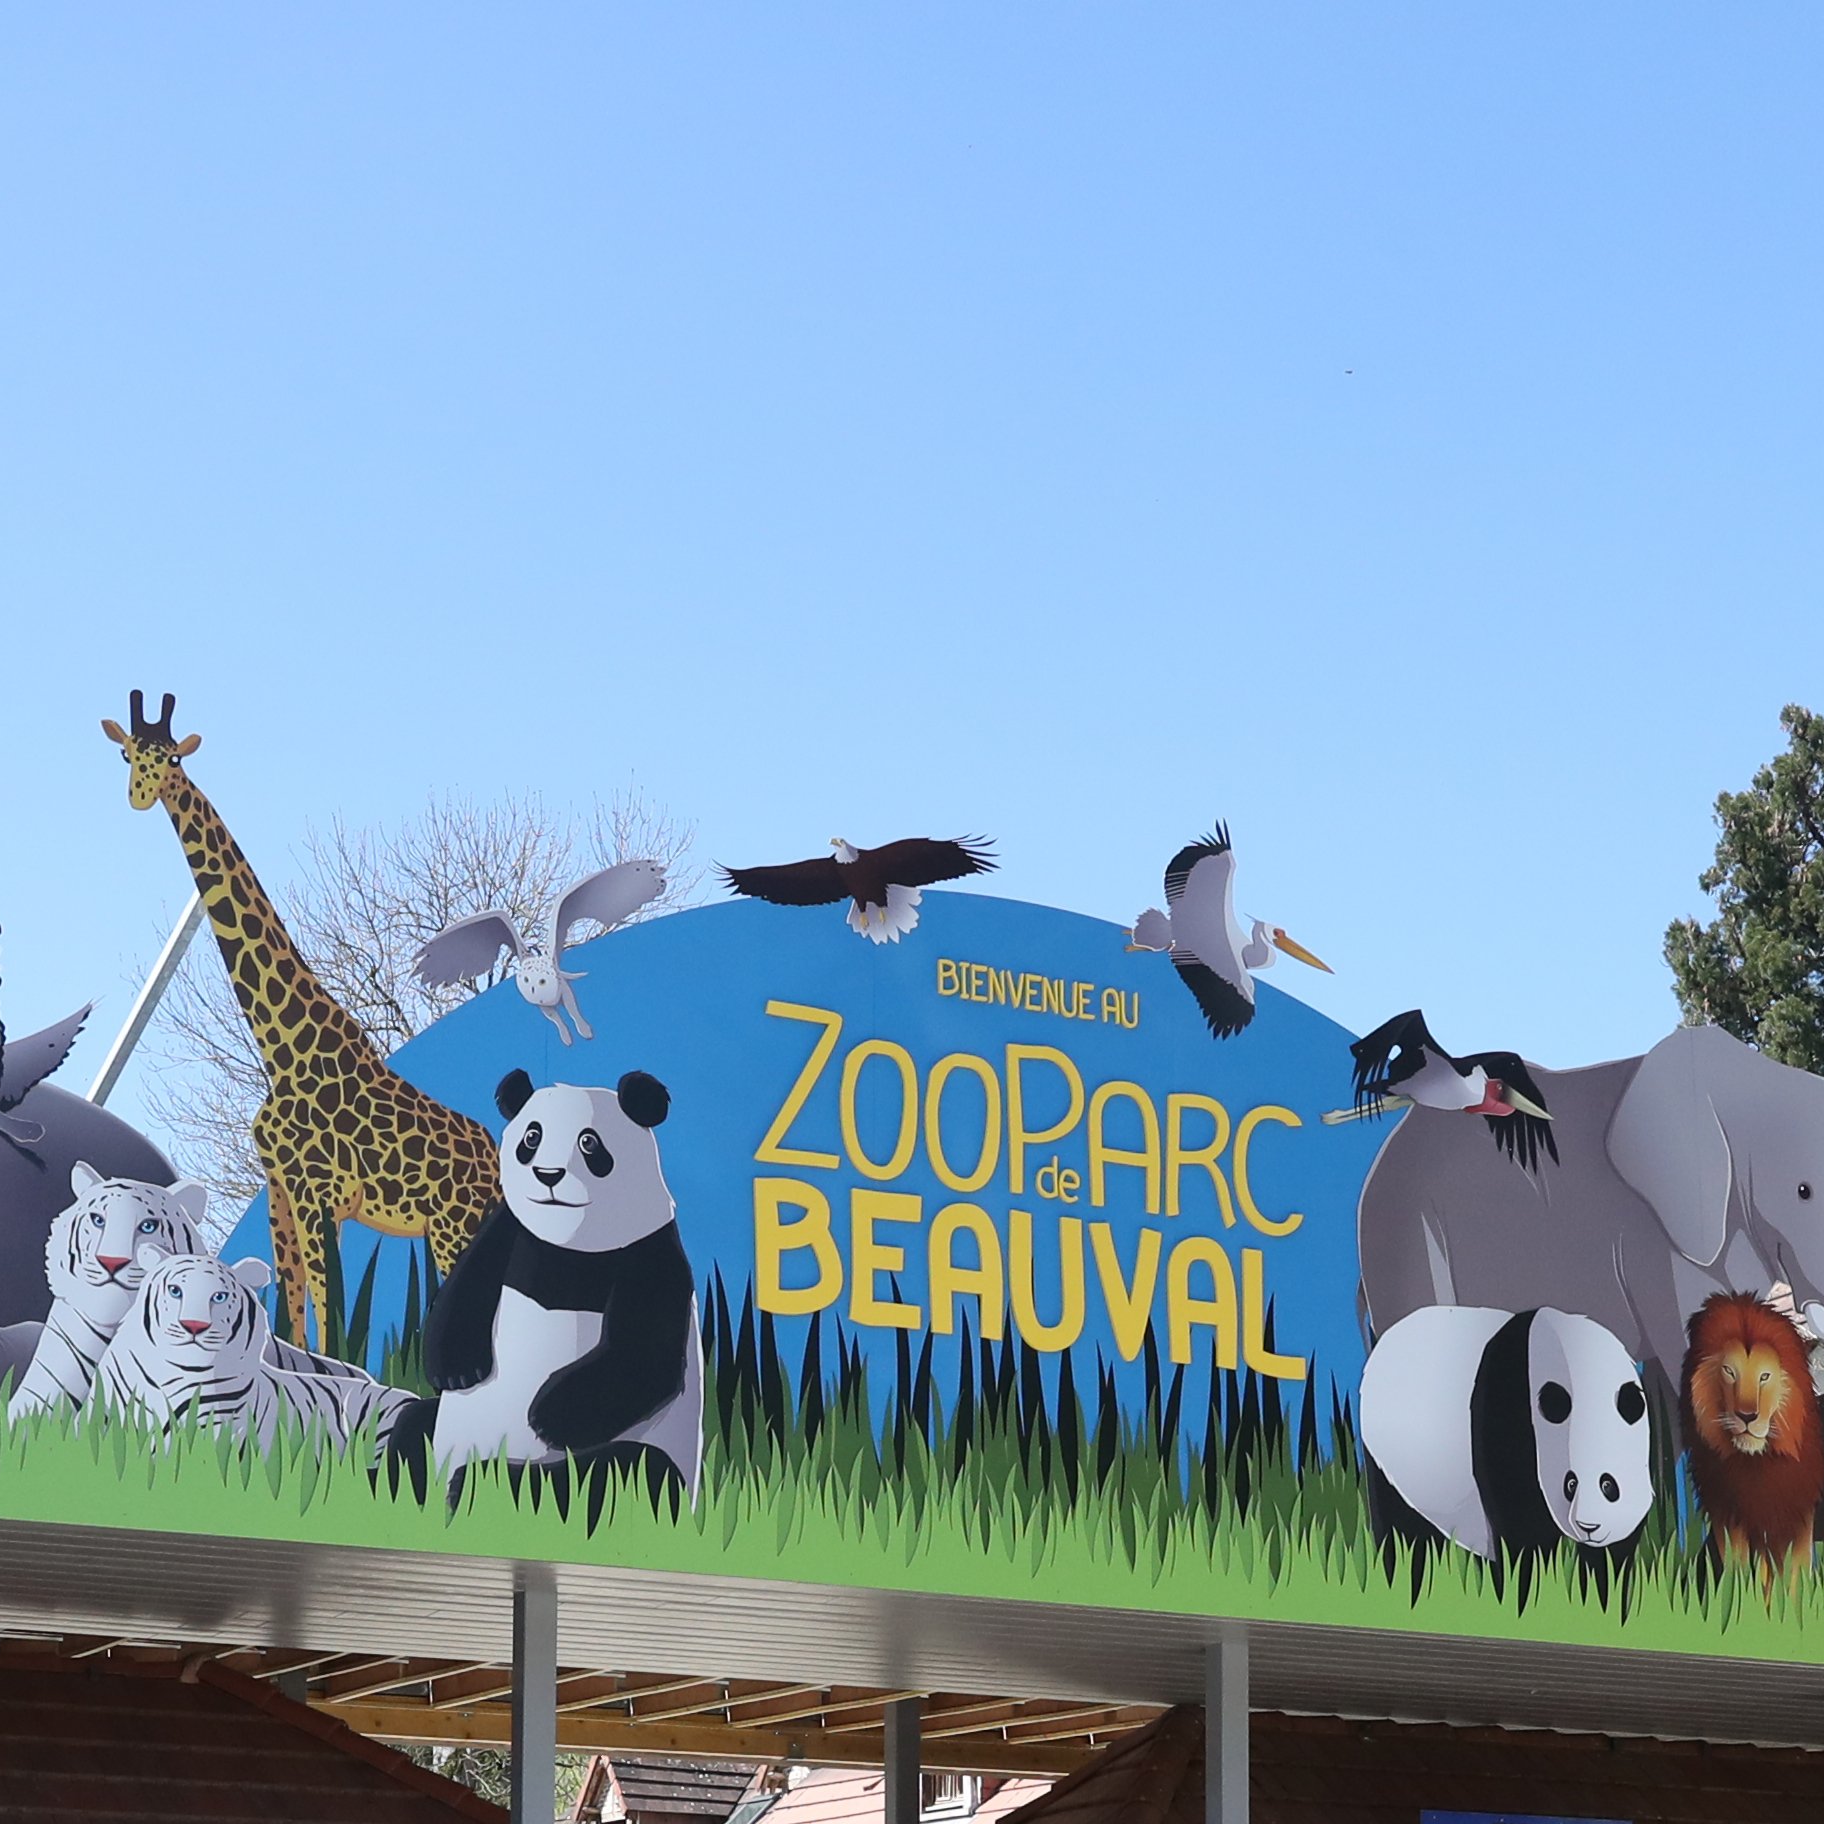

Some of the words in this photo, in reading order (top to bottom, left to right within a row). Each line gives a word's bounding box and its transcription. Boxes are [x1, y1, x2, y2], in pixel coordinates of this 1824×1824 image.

[937, 958, 1095, 1021] BIENVENUE
[1102, 987, 1139, 1029] AU
[1036, 1156, 1081, 1203] de
[754, 1178, 1307, 1381] BEAUVAL
